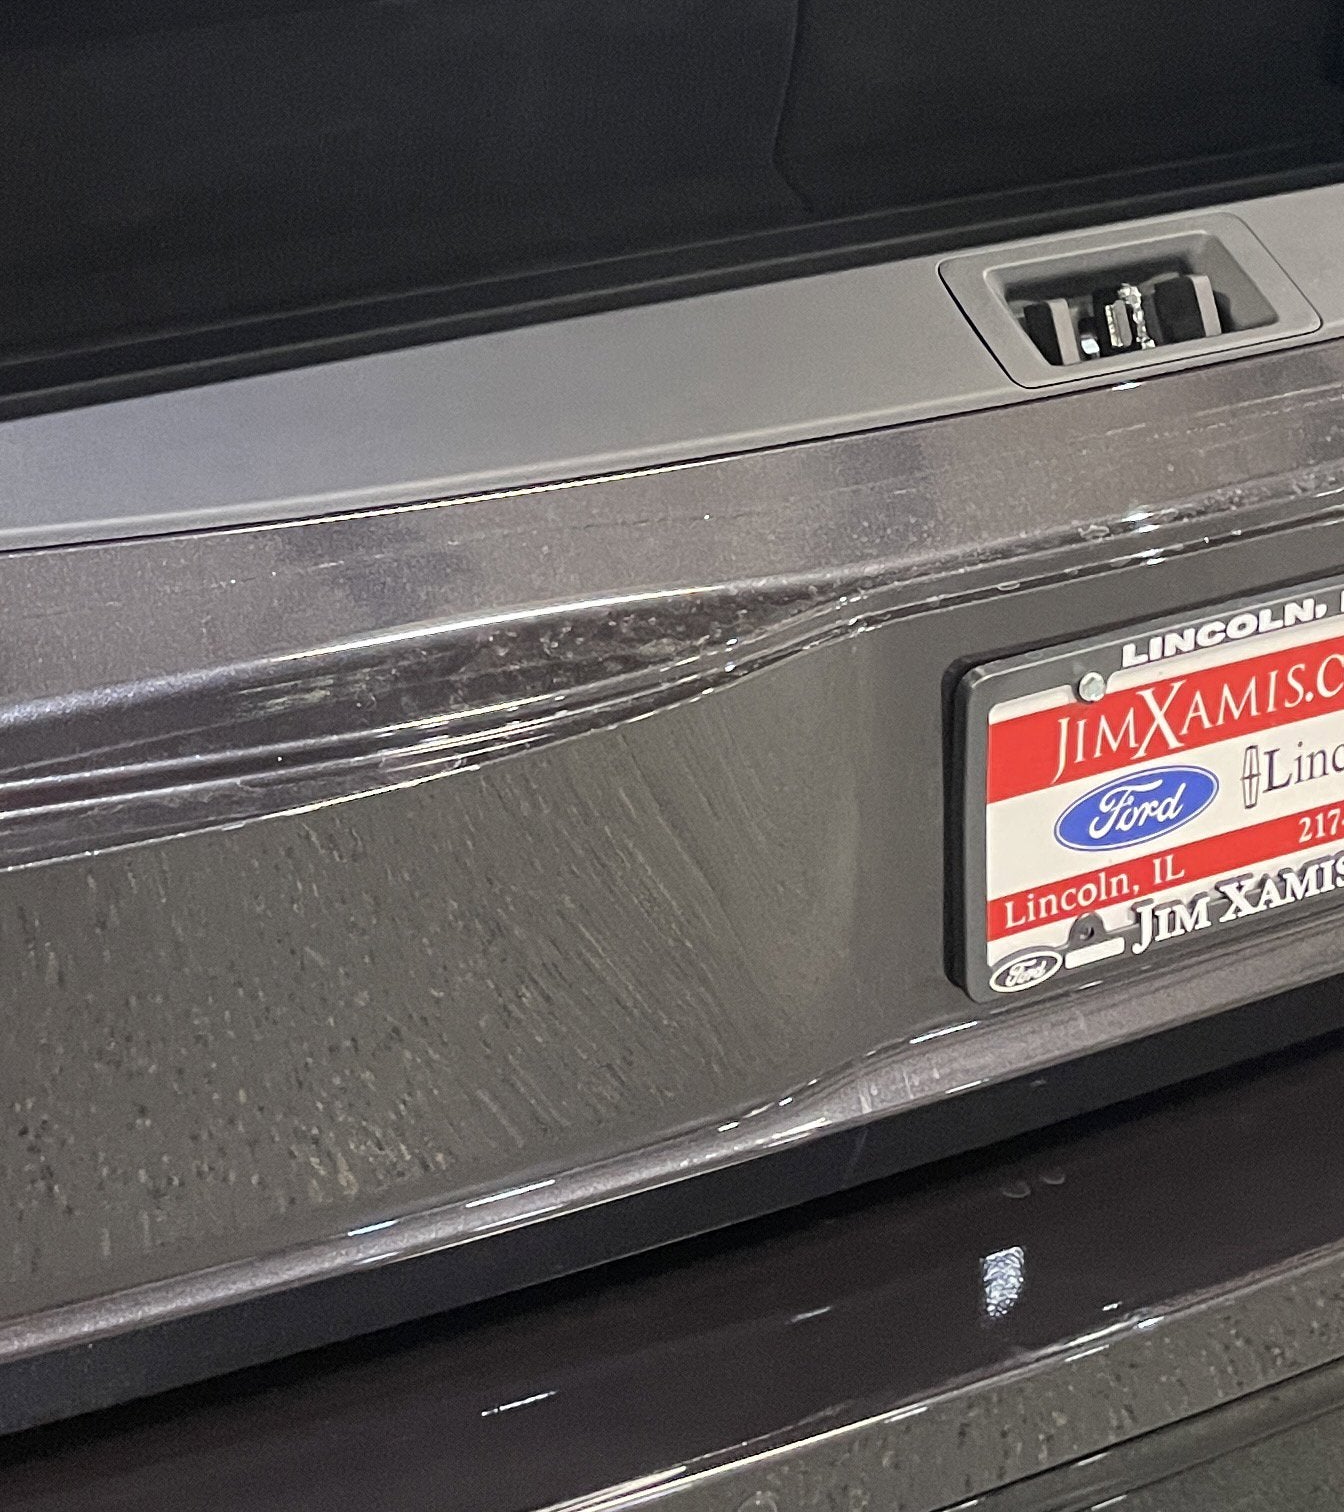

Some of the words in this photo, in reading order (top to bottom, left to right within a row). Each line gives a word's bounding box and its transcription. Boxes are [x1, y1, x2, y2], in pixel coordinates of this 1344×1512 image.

[1120, 597, 1328, 670] LINCOLN,
[1088, 781, 1184, 841] Ford
[1003, 872, 1142, 929] Lincoln,
[1152, 857, 1186, 889] IL
[1130, 898, 1212, 955] JIM
[1005, 959, 1047, 987] Ford
